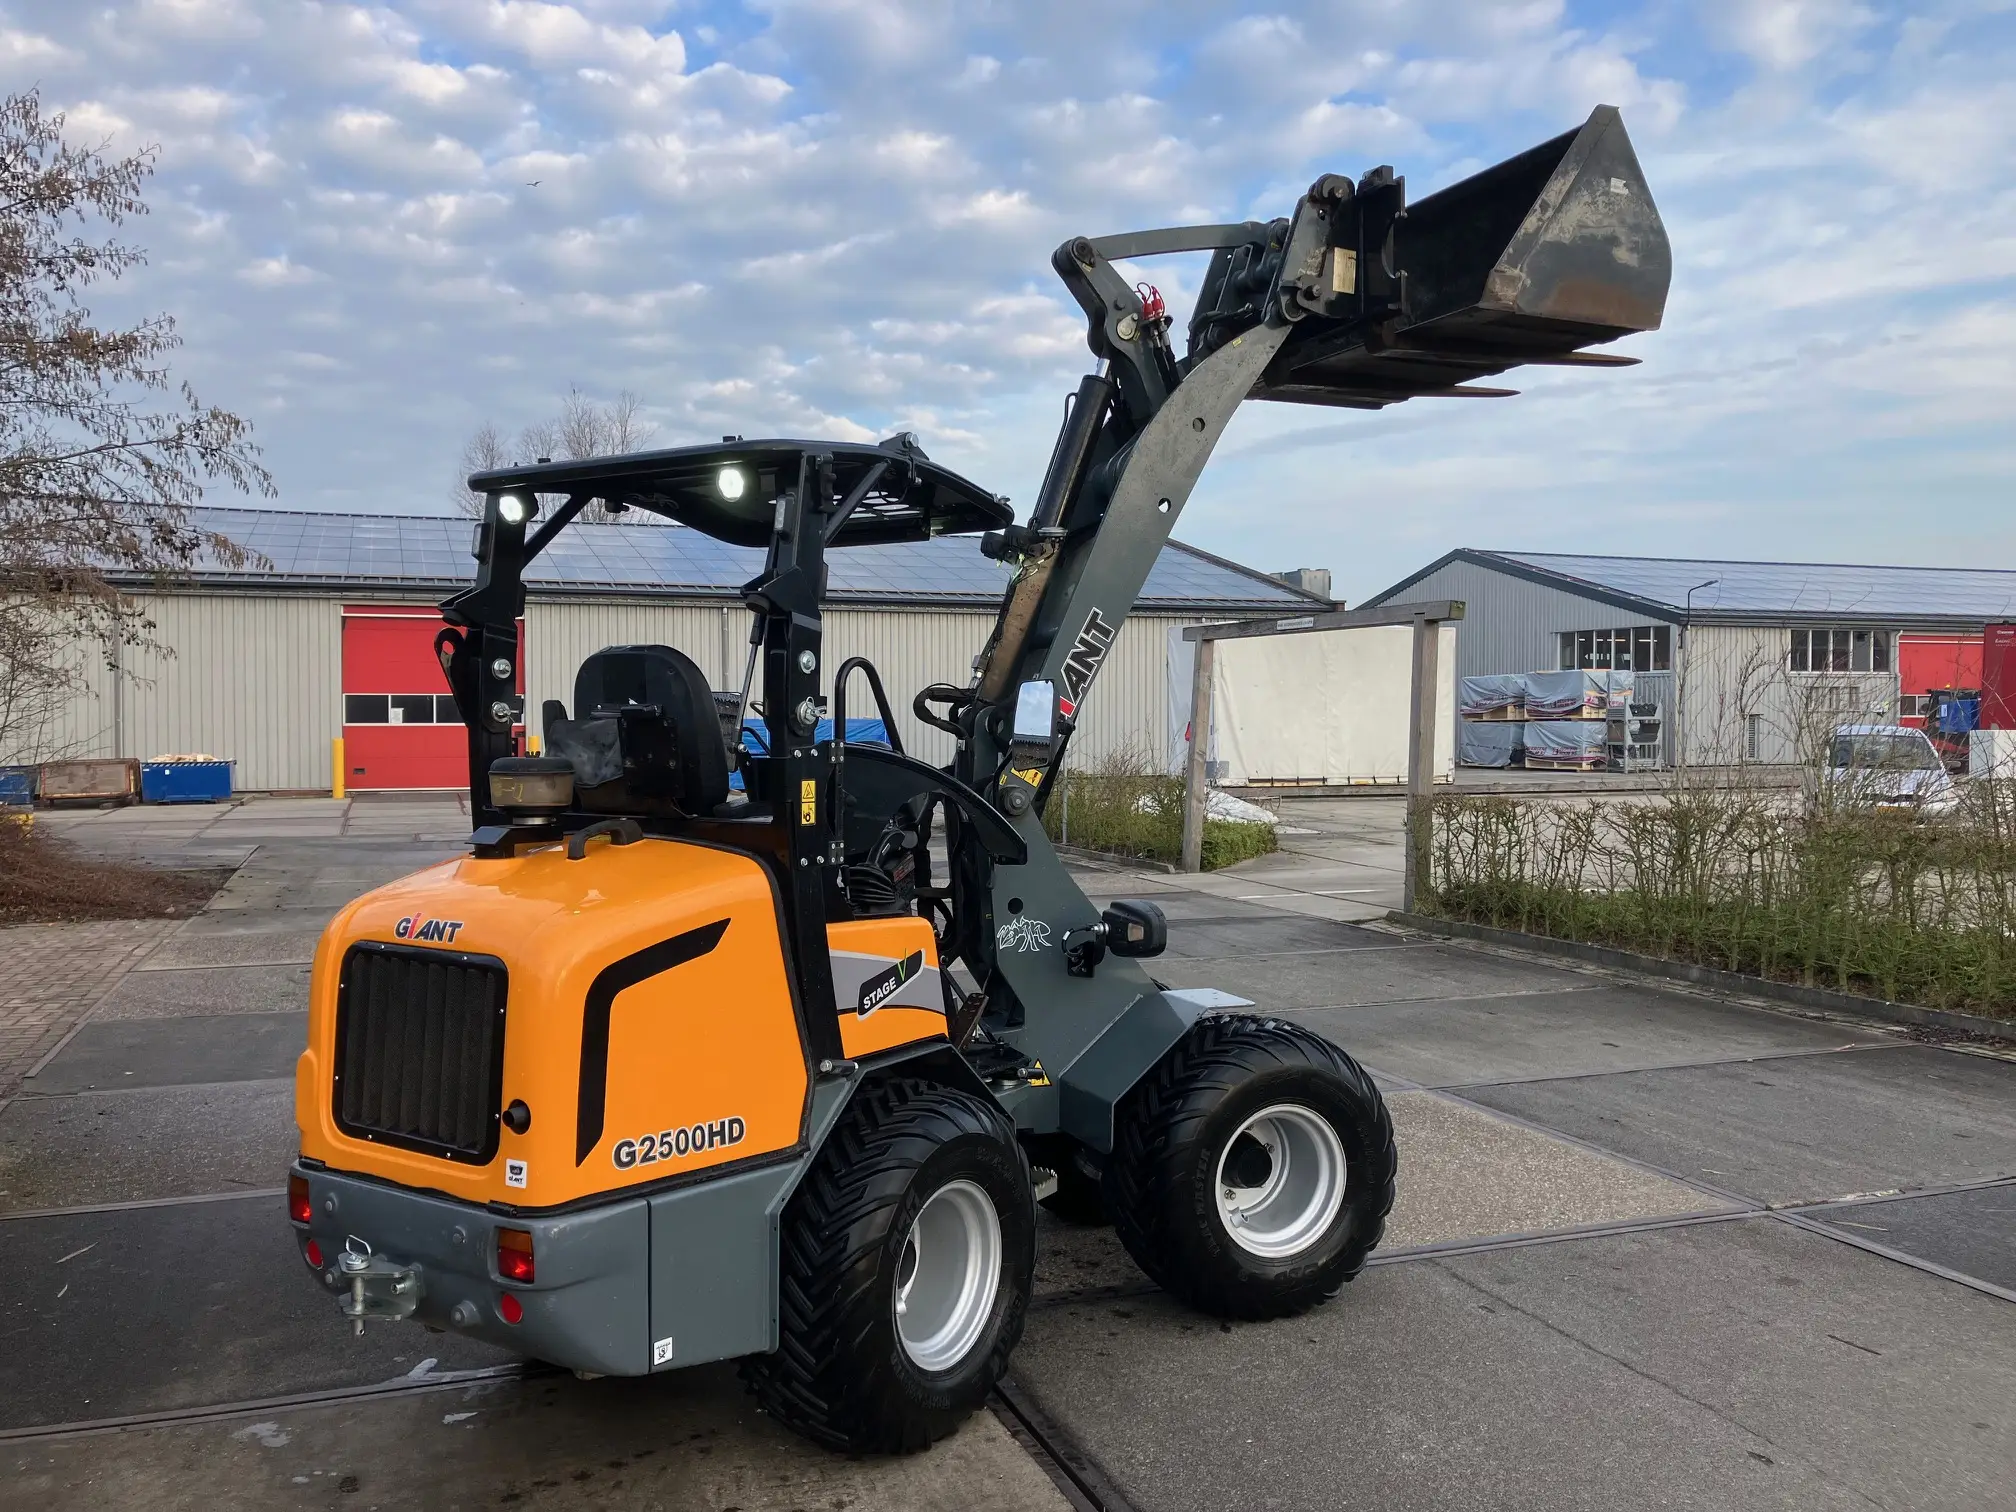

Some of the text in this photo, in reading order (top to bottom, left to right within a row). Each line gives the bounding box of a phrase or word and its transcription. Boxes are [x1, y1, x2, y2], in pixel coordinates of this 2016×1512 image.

[1060, 606, 1116, 717] ANT
[863, 948, 908, 1009] STAGE V
[612, 1116, 746, 1170] G2500HD
